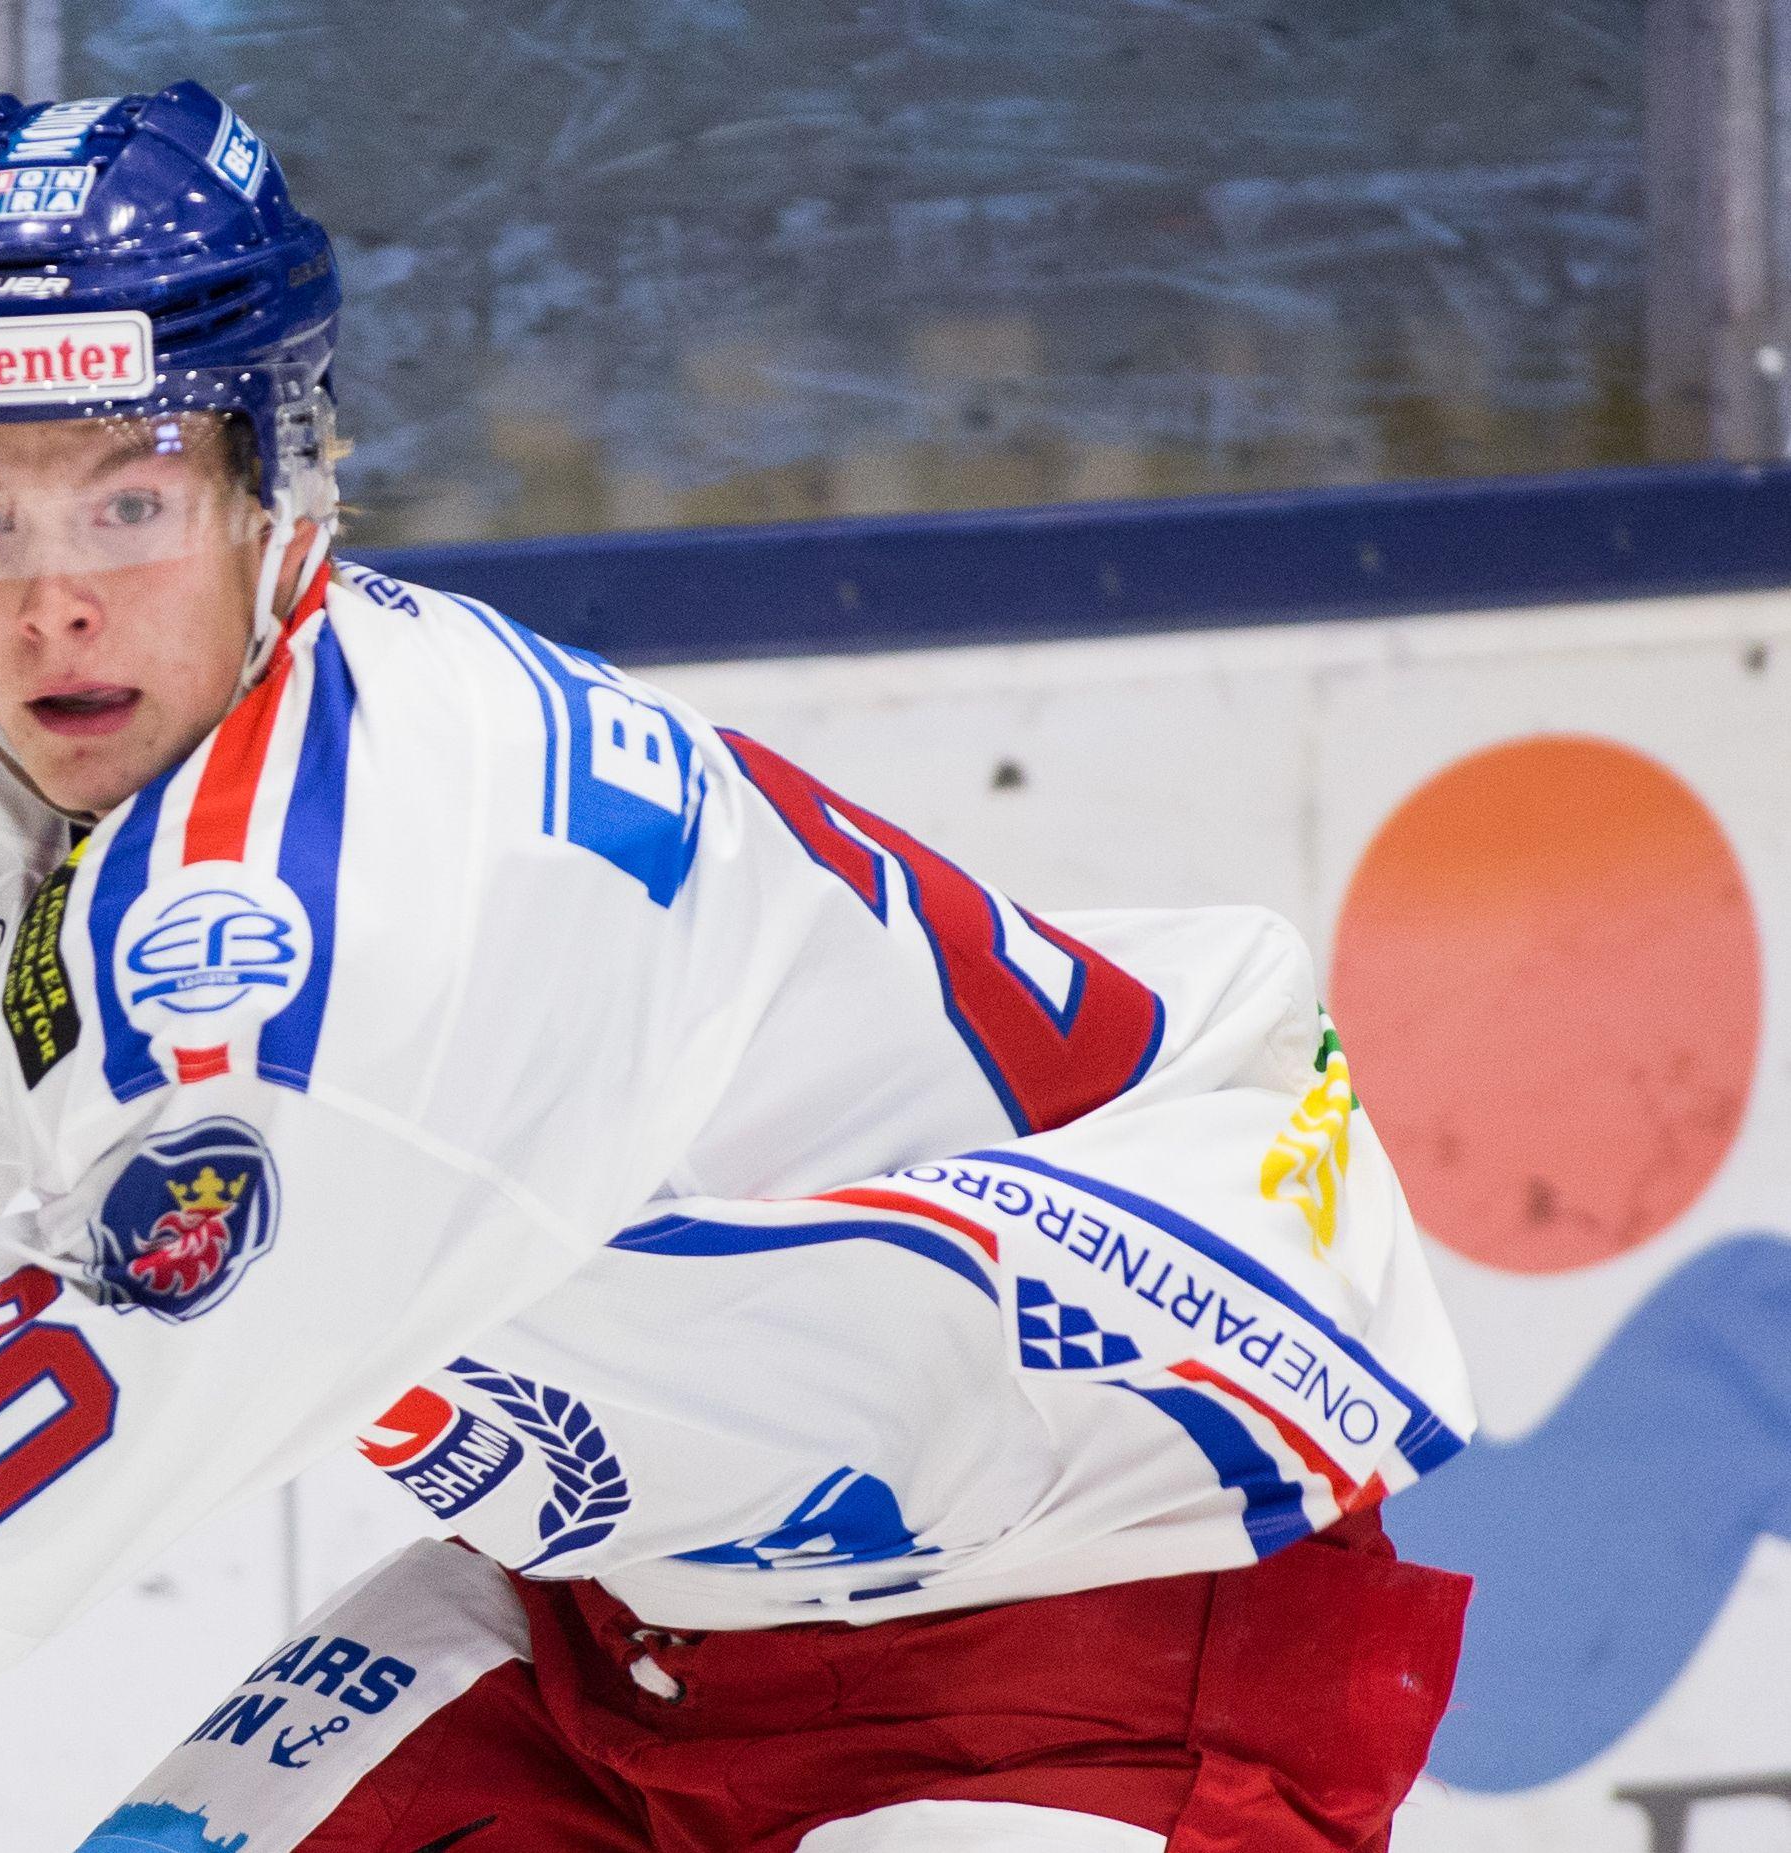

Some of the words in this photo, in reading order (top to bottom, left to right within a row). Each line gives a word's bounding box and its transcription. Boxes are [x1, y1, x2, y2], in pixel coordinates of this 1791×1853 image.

[886, 1165, 1380, 1446] ONEPARTNERGRO
[400, 1418, 511, 1512] SHAMN
[241, 1634, 418, 1715] ARS
[183, 1693, 289, 1746] IN
